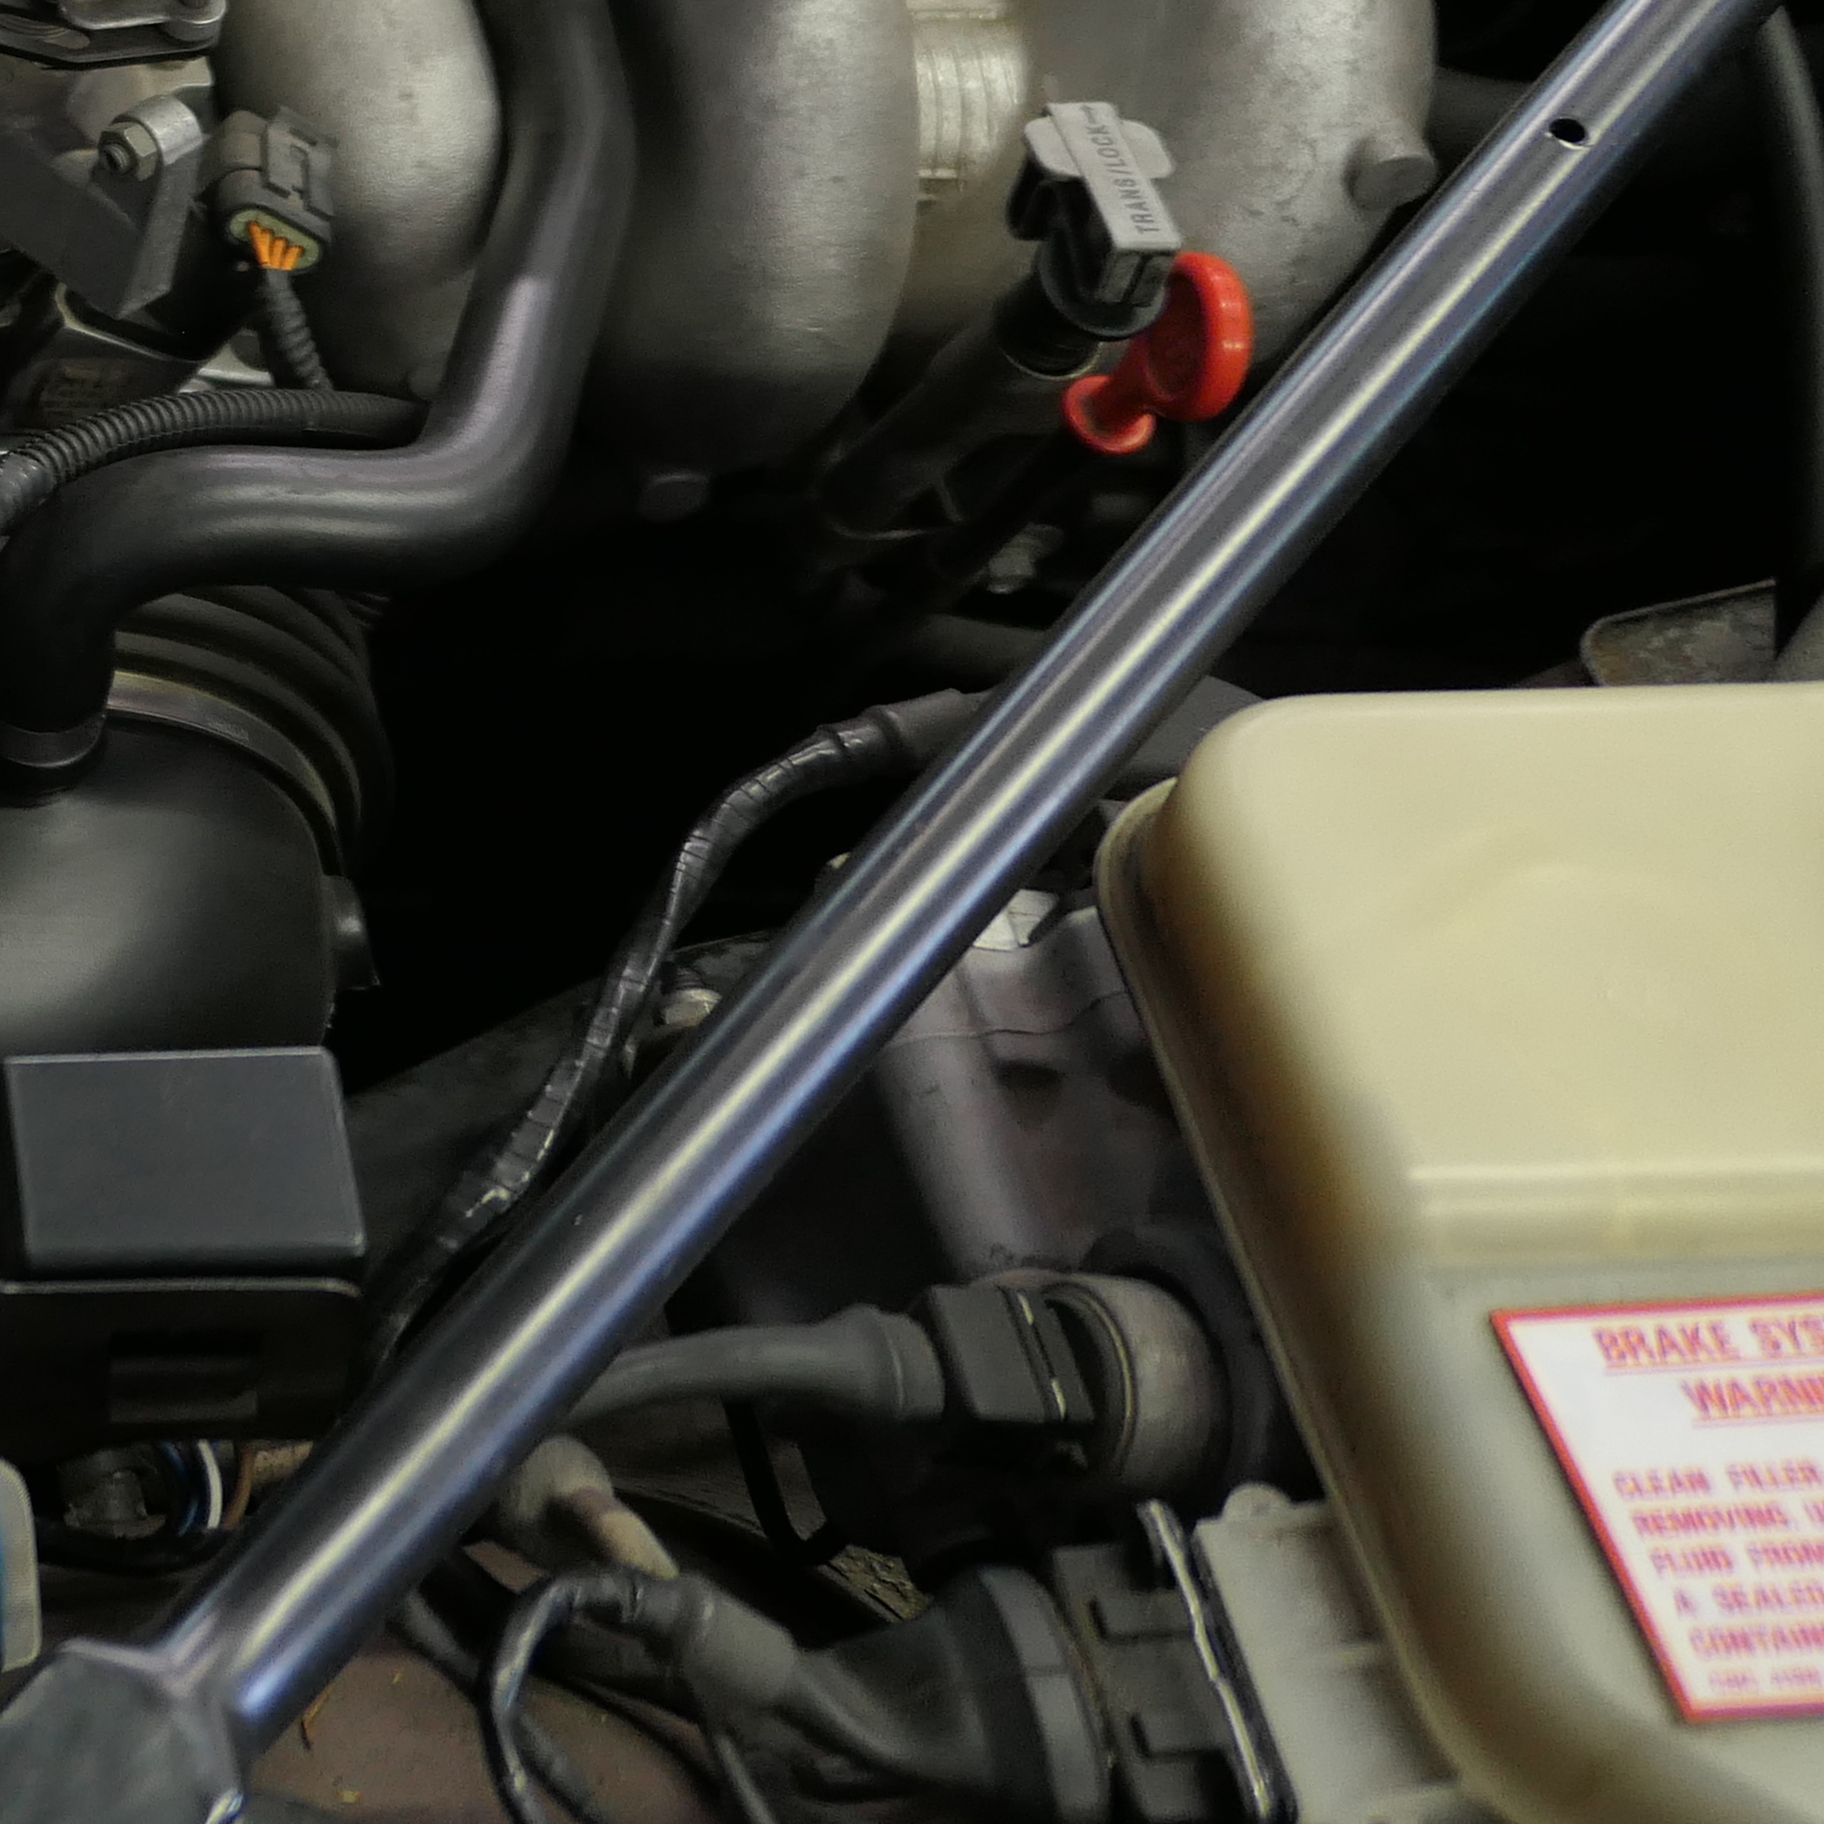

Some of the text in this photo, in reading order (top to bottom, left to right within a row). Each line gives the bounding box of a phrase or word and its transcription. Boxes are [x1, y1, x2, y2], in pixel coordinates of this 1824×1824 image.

[1086, 124, 1160, 235] TRANS/LOCK
[1592, 1321, 1742, 1369] BRAKE
[1612, 1459, 1824, 1500] CLEAN FILLER
[1649, 1546, 1735, 1580] FLUID
